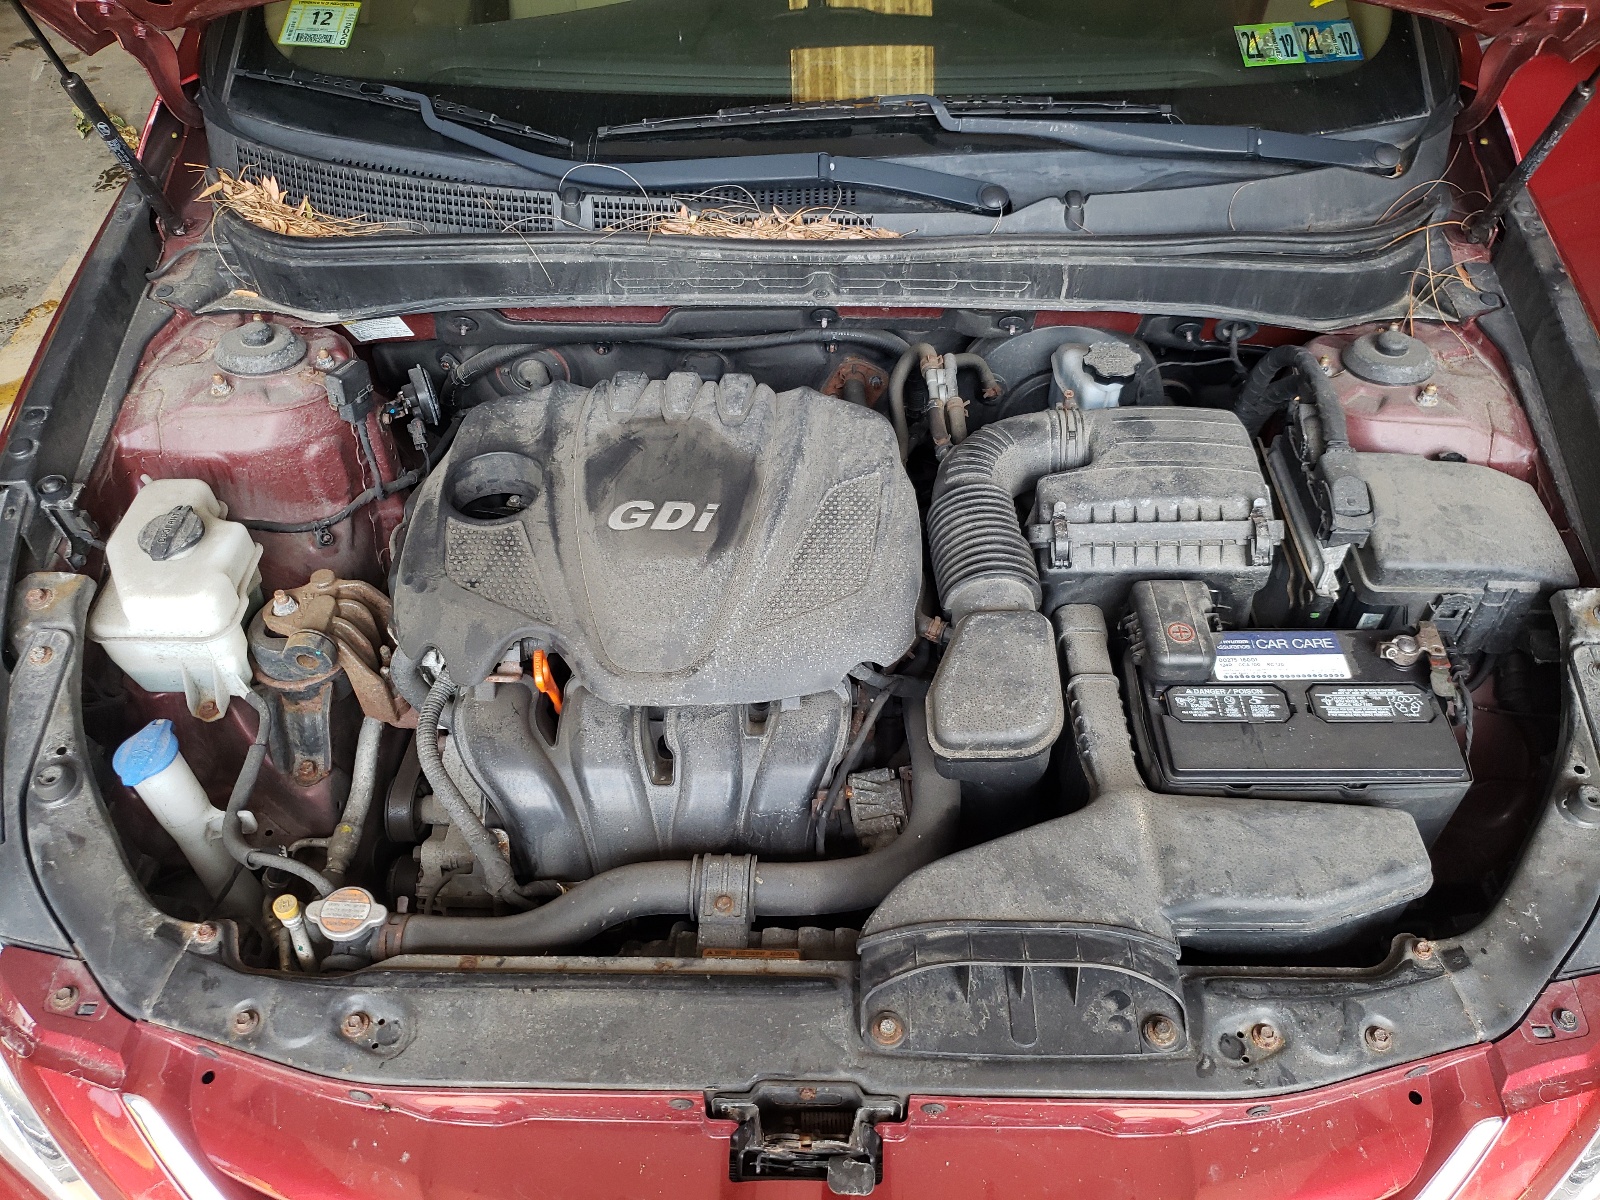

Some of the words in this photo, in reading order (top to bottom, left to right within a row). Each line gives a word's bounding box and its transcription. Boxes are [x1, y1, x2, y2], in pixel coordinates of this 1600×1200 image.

[312, 11, 333, 26] 12
[1240, 31, 1264, 59] 21
[1279, 33, 1298, 58] 12
[1300, 27, 1324, 55] 21
[1337, 31, 1357, 56] 12
[608, 500, 721, 532] GDi
[1255, 639, 1289, 649] CAR
[1291, 638, 1336, 649] CARE
